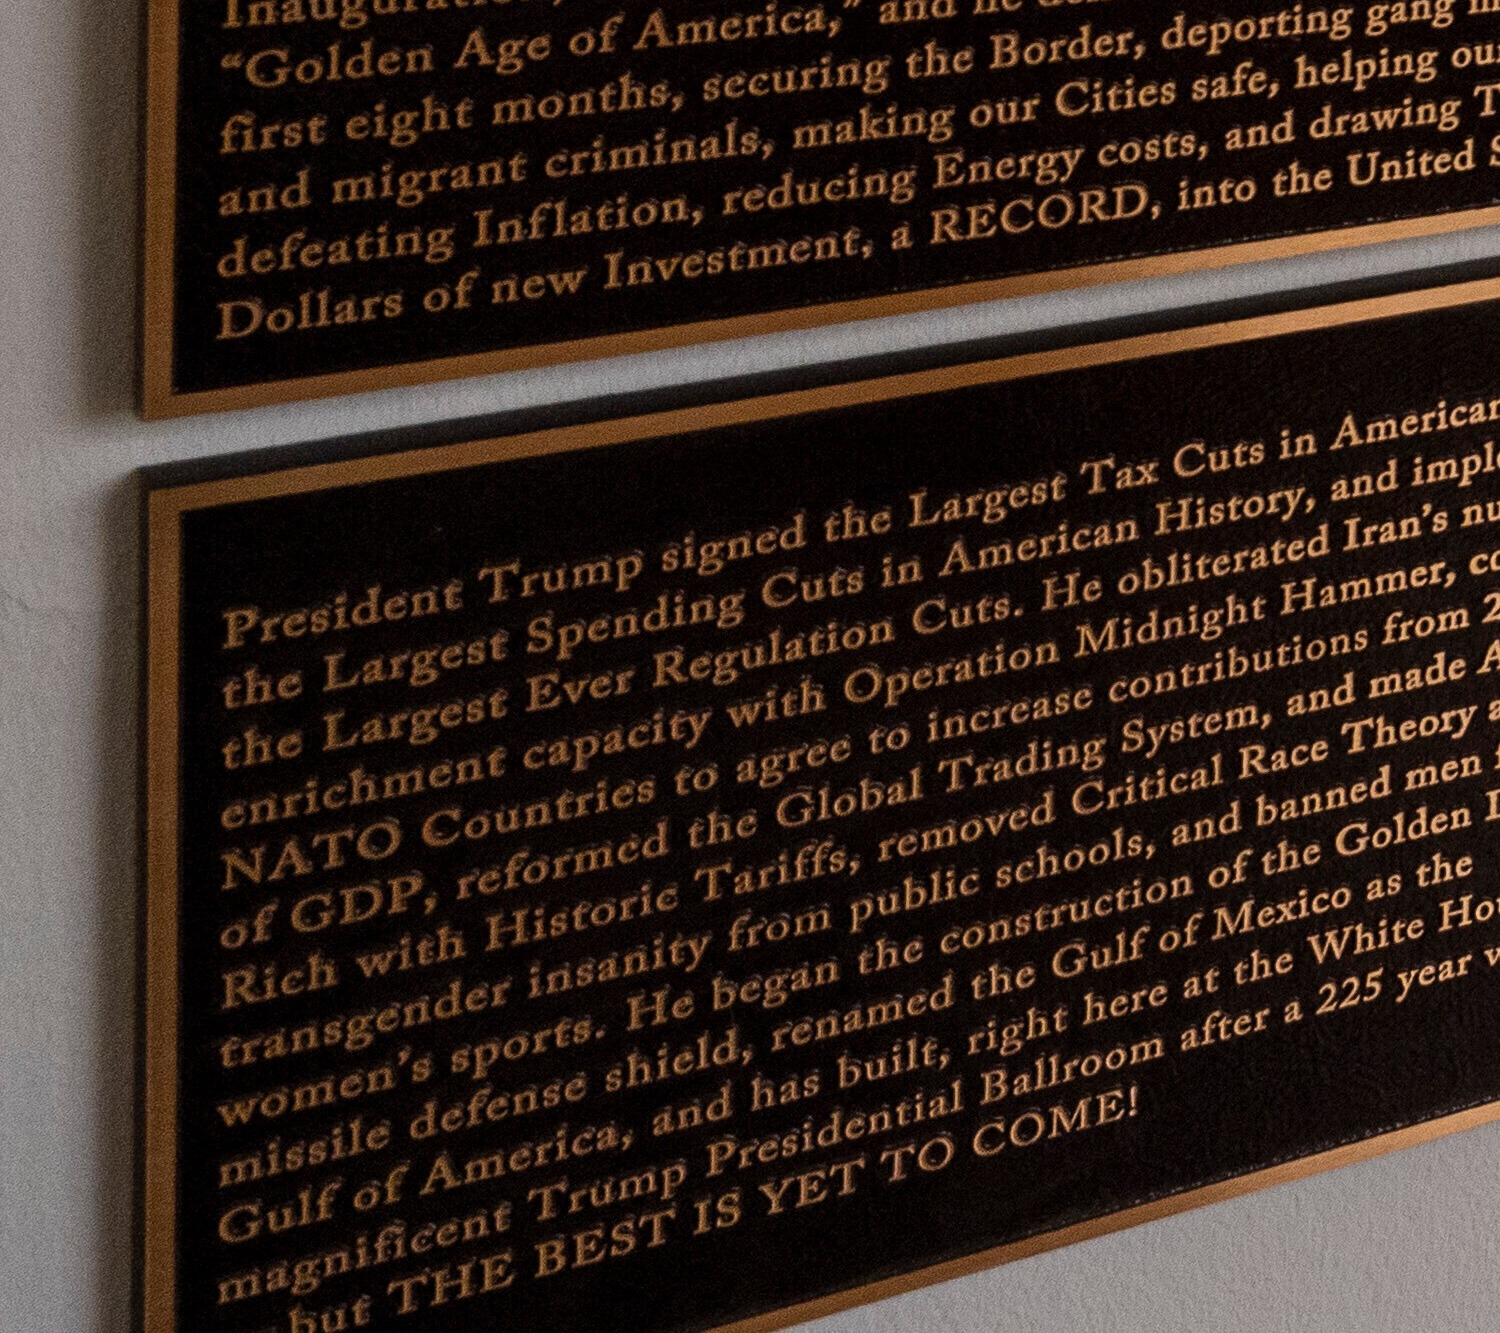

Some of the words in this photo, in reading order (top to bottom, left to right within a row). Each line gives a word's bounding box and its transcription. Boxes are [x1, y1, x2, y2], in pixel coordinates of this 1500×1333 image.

[218, 290, 402, 339] Dollars
[423, 271, 478, 312] of
[492, 270, 586, 304] new
[605, 228, 872, 289] Investment,
[891, 225, 912, 250] a
[930, 183, 1161, 245] RECORD,
[1178, 178, 1257, 211] into
[1272, 160, 1333, 198] the
[1347, 137, 1476, 187] United
[223, 820, 401, 889] NATO
[421, 780, 654, 846] Countries
[674, 765, 718, 795] to
[736, 739, 850, 788] agree
[869, 727, 910, 754] to
[928, 688, 1092, 742] increase
[1108, 628, 1369, 703] contributions
[1382, 607, 1470, 646] from
